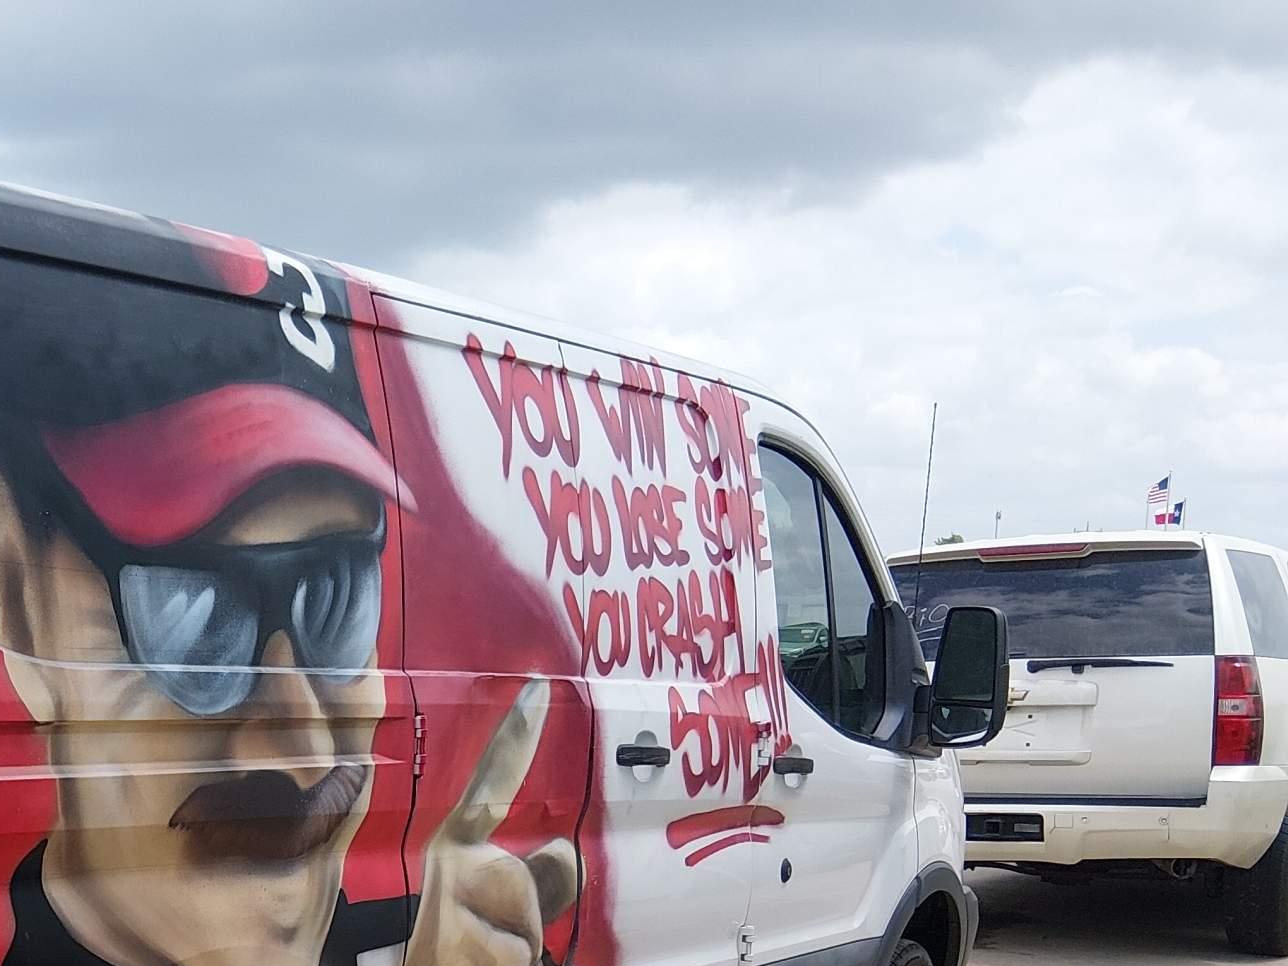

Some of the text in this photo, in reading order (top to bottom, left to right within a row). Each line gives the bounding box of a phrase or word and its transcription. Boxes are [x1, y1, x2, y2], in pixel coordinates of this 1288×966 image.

[462, 332, 764, 498] YOU WIN SOME
[521, 465, 773, 579] YOU LOSE SOME
[562, 565, 746, 684] YOU CRASH
